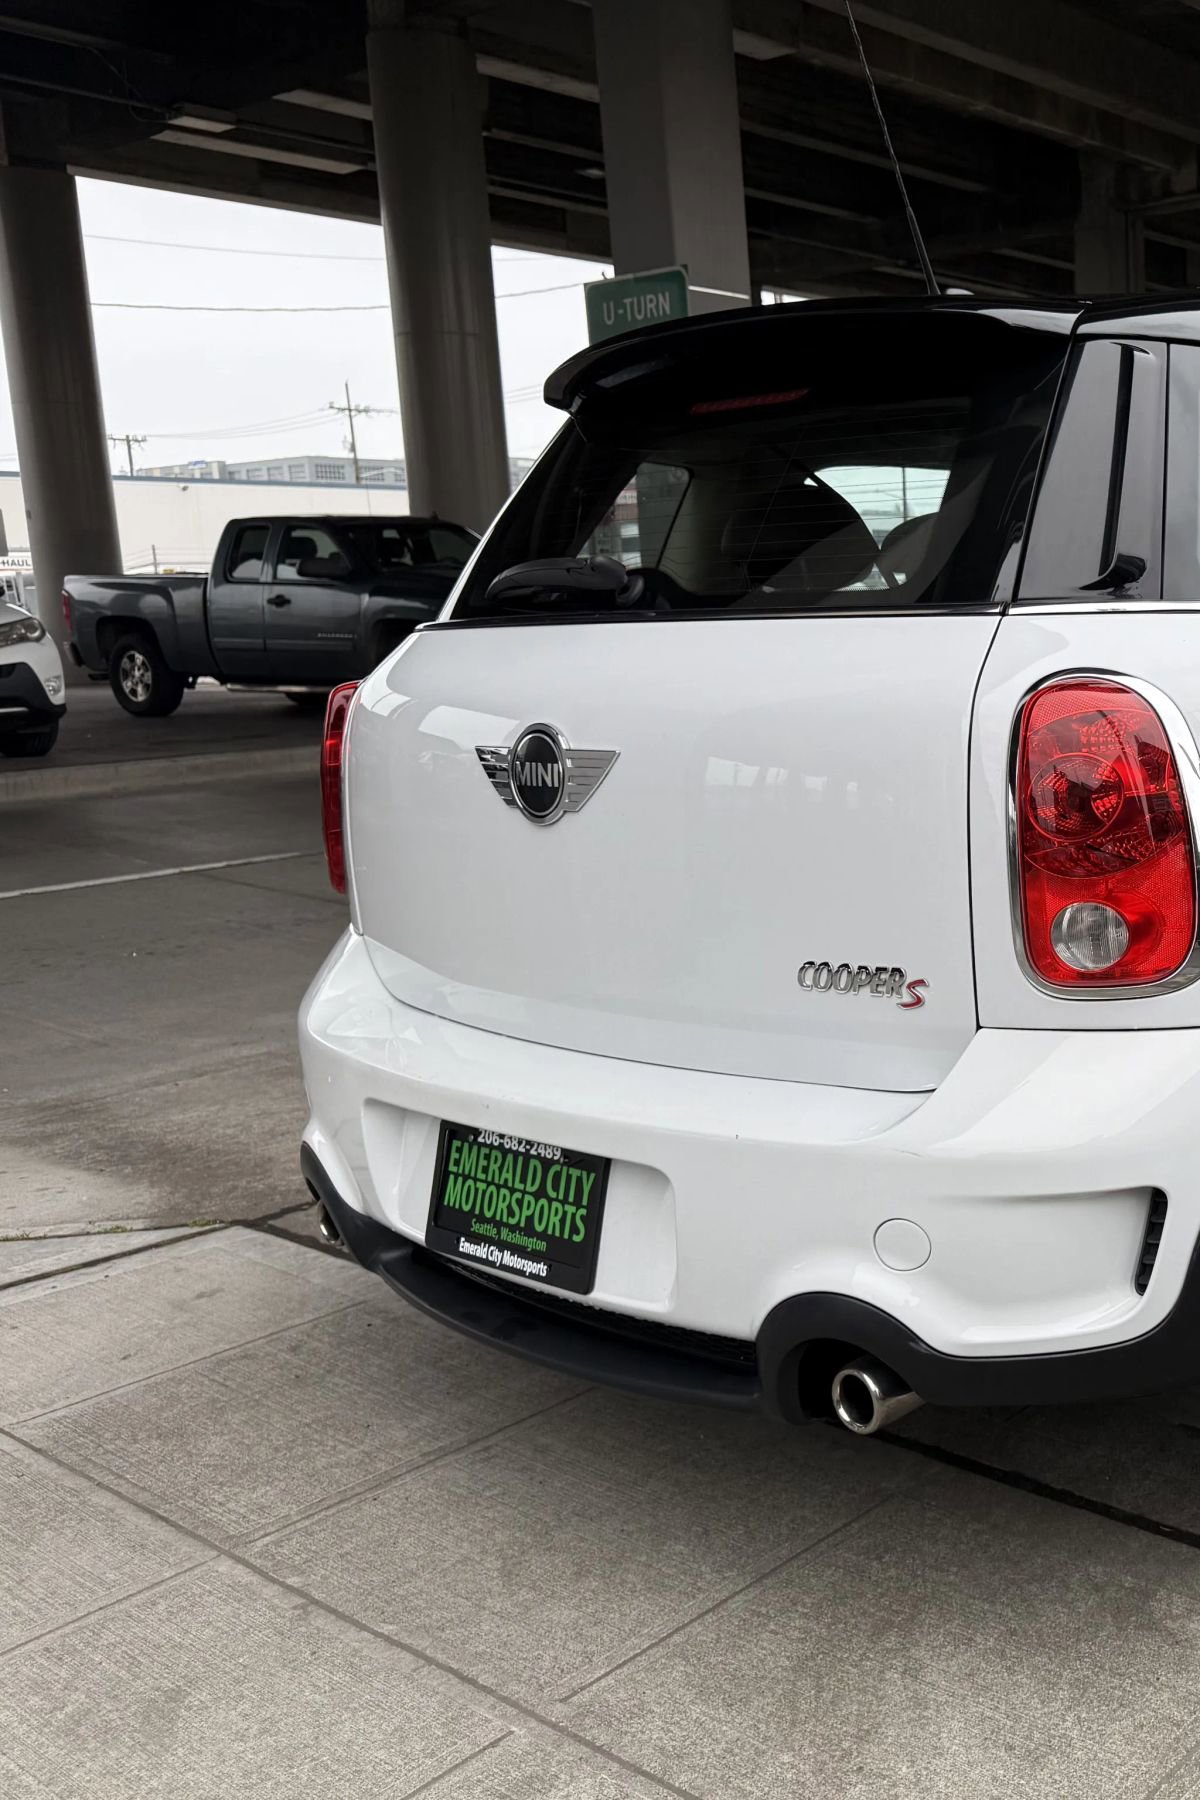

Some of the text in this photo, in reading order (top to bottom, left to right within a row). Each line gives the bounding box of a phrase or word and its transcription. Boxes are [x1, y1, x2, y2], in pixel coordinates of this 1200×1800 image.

[603, 291, 671, 325] U-TURN
[516, 761, 559, 787] MINI
[797, 960, 907, 998] COOPER
[477, 1128, 562, 1160] 206-682-2489
[448, 1139, 596, 1206] EMERALD CITY
[443, 1174, 588, 1243] MOTORSPORTS
[470, 1218, 547, 1252] Seattle, Washington
[459, 1237, 548, 1277] Emerald City Motorsports
